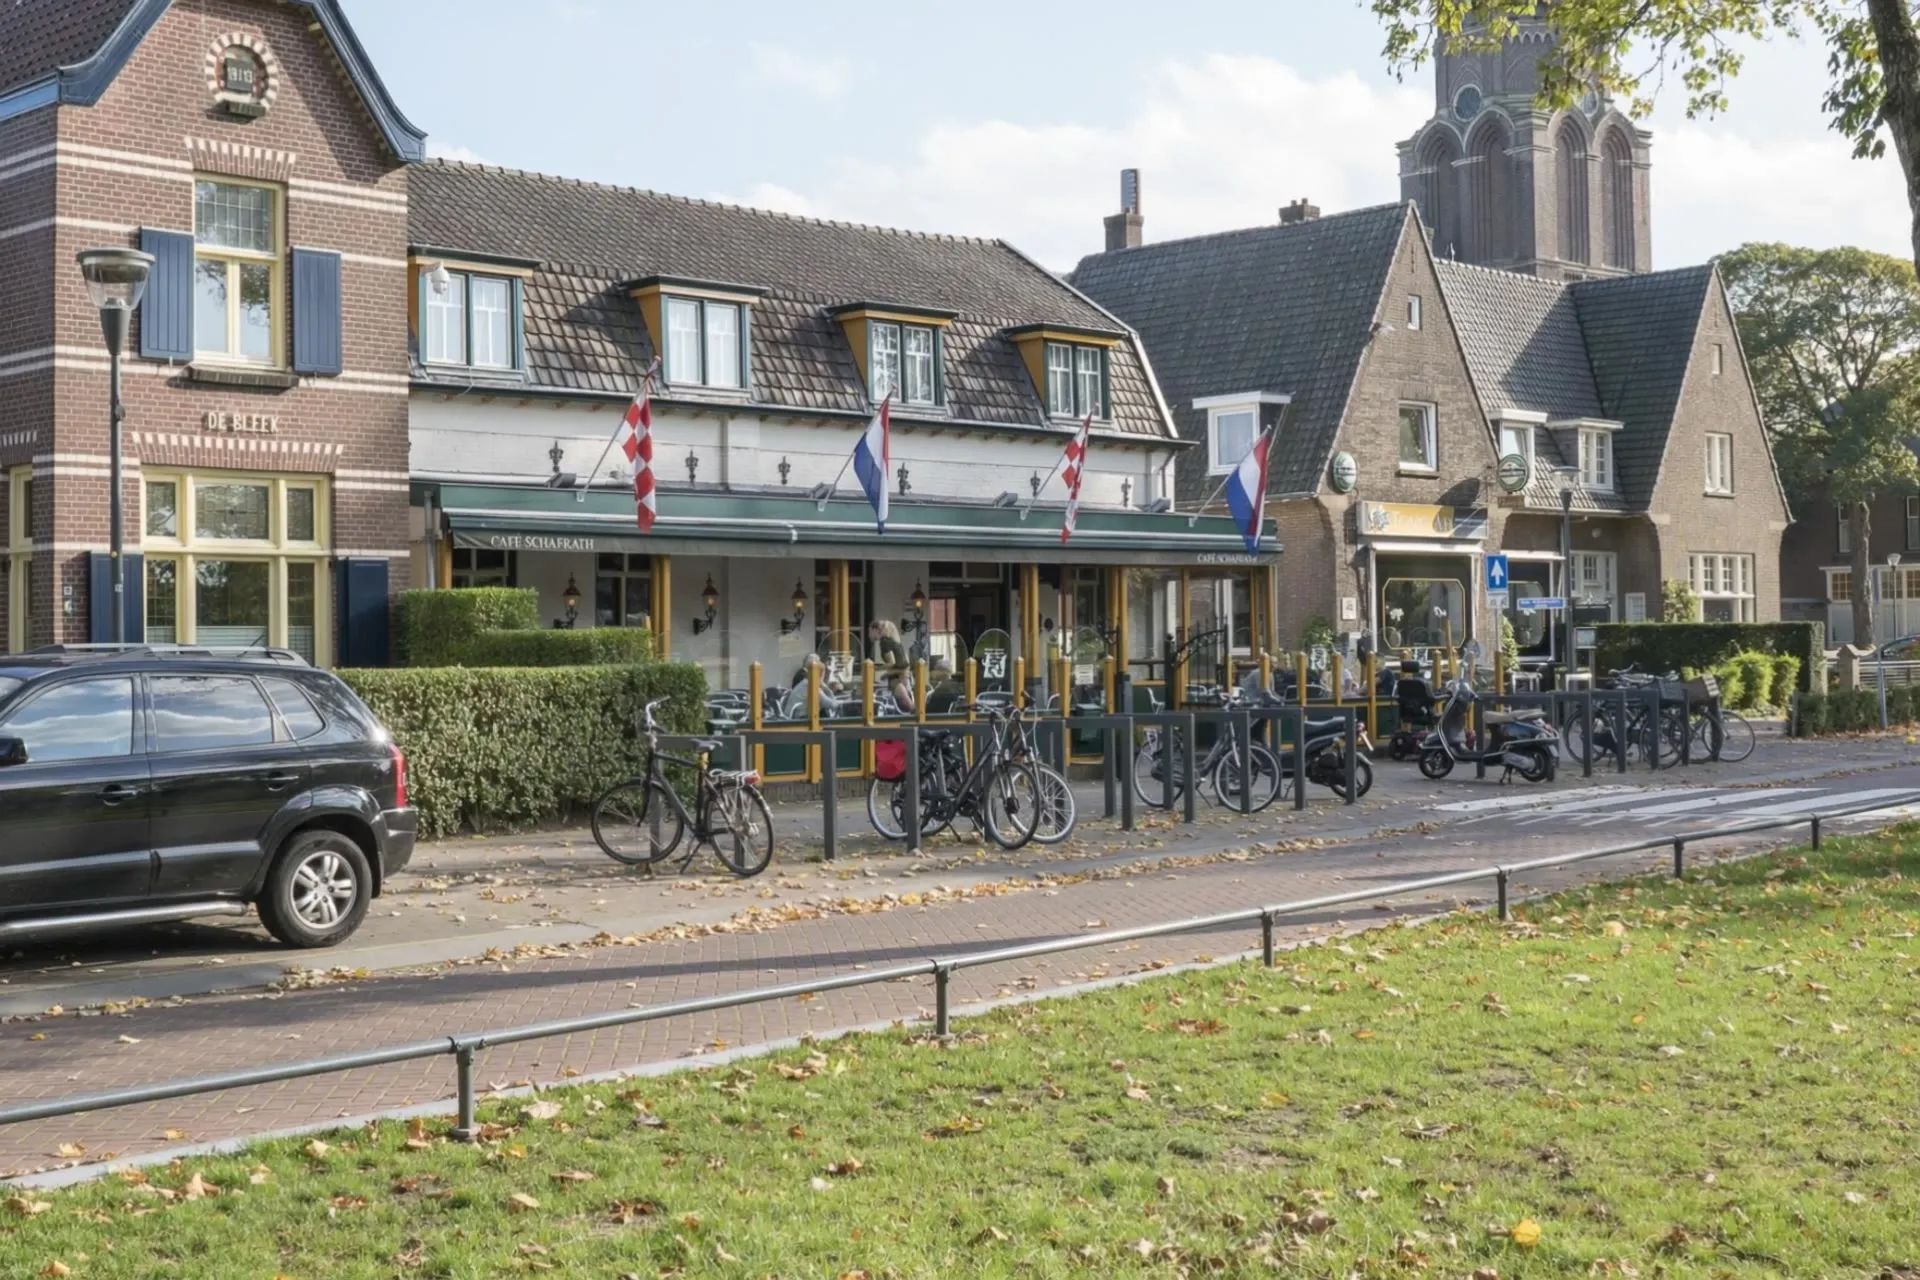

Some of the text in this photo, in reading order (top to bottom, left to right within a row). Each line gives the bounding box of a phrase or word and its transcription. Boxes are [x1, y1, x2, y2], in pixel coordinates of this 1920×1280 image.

[208, 411, 227, 430] DE
[490, 532, 594, 551] CAFÉ SCHAFRATH
